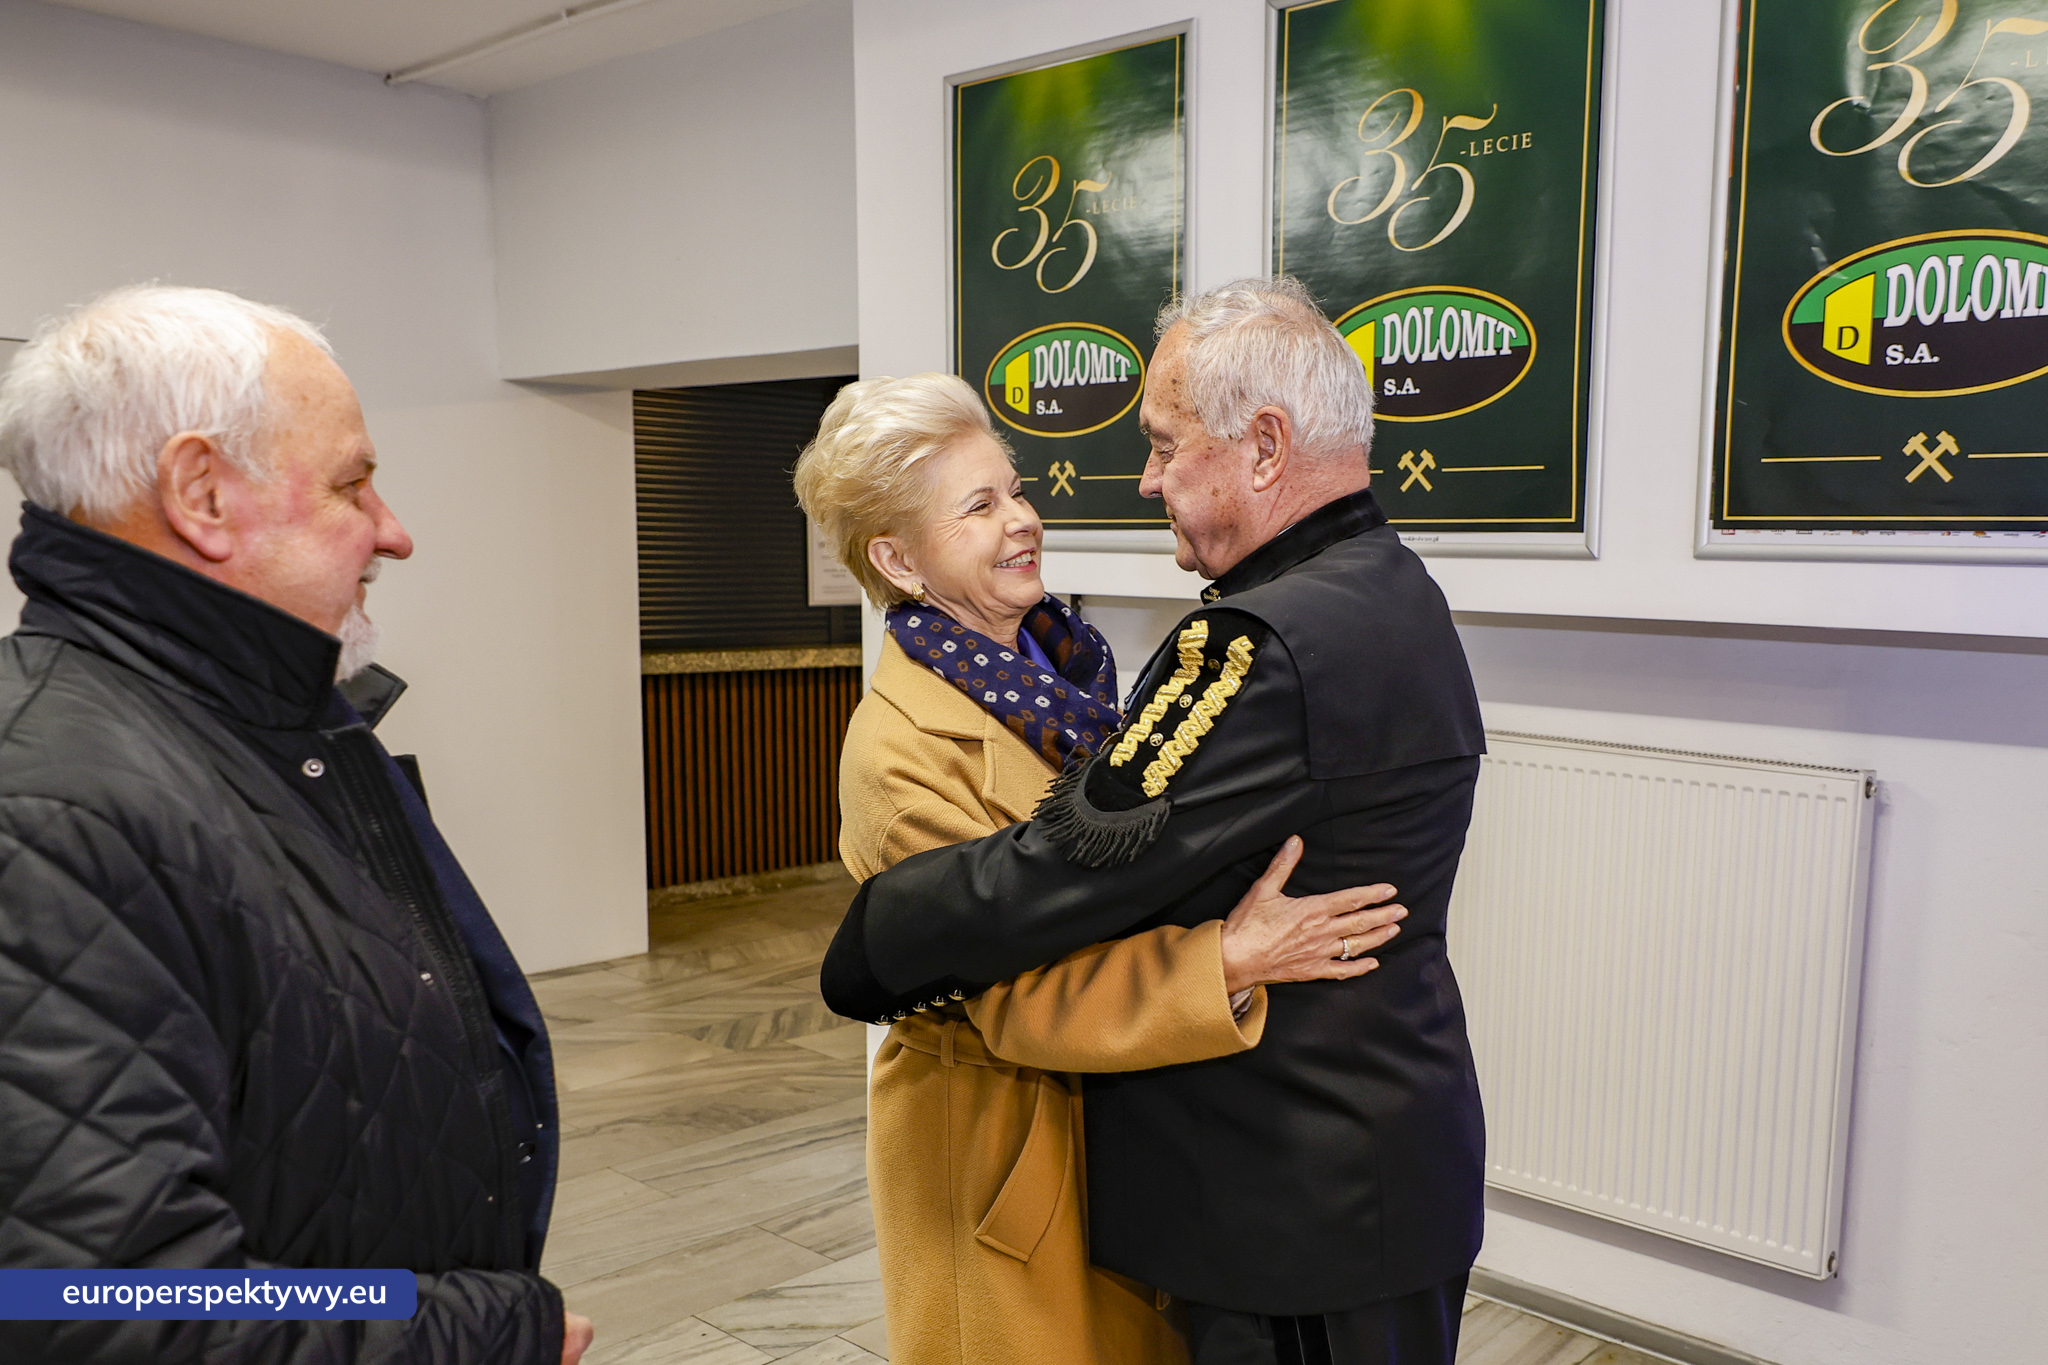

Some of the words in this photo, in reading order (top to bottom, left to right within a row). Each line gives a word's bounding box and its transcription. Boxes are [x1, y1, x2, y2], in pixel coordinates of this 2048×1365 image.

[1327, 88, 1498, 252] 35
[991, 155, 1112, 294] 35
[1381, 306, 1517, 365] DOLOMIT
[1836, 325, 1860, 351] D
[1033, 339, 1132, 389] DOLOMIT
[1885, 343, 1940, 366] S.A.
[1012, 386, 1024, 404] D
[1383, 378, 1421, 397] S.A.
[1036, 400, 1063, 415] S.A.
